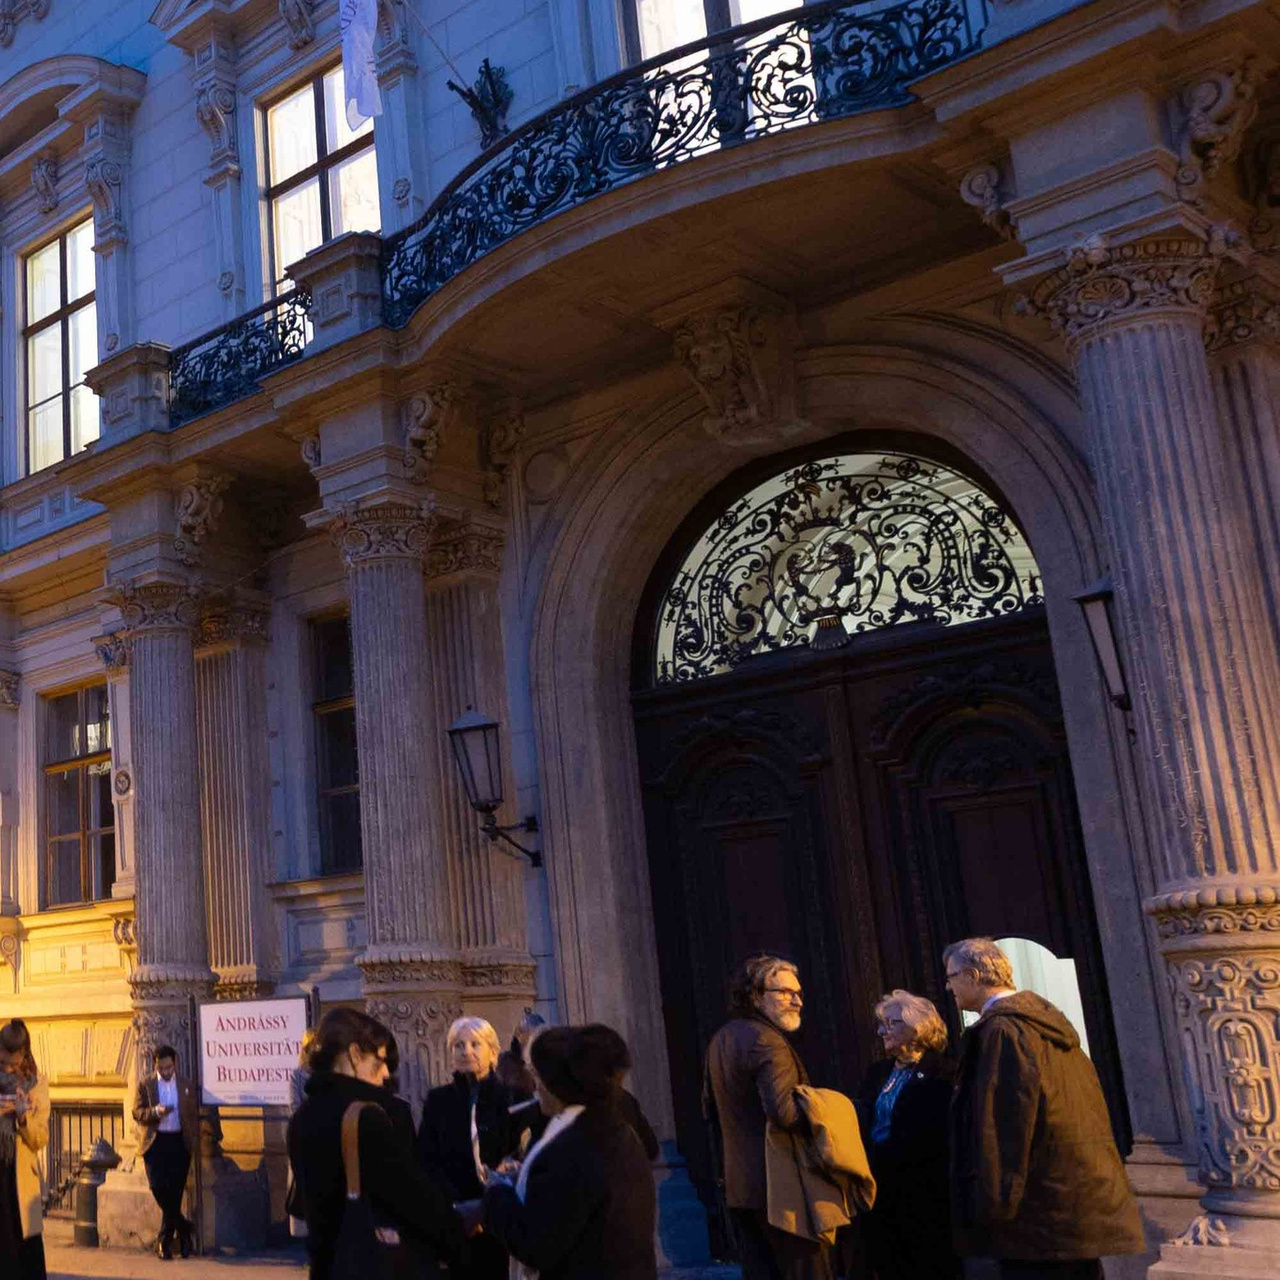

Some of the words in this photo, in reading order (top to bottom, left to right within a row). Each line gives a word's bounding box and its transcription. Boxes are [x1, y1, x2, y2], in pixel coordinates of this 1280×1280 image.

[216, 1012, 289, 1031] ANDRÁSSY
[206, 1037, 302, 1058] UNIVERSITÄT
[217, 1065, 292, 1083] BUDAPEST
